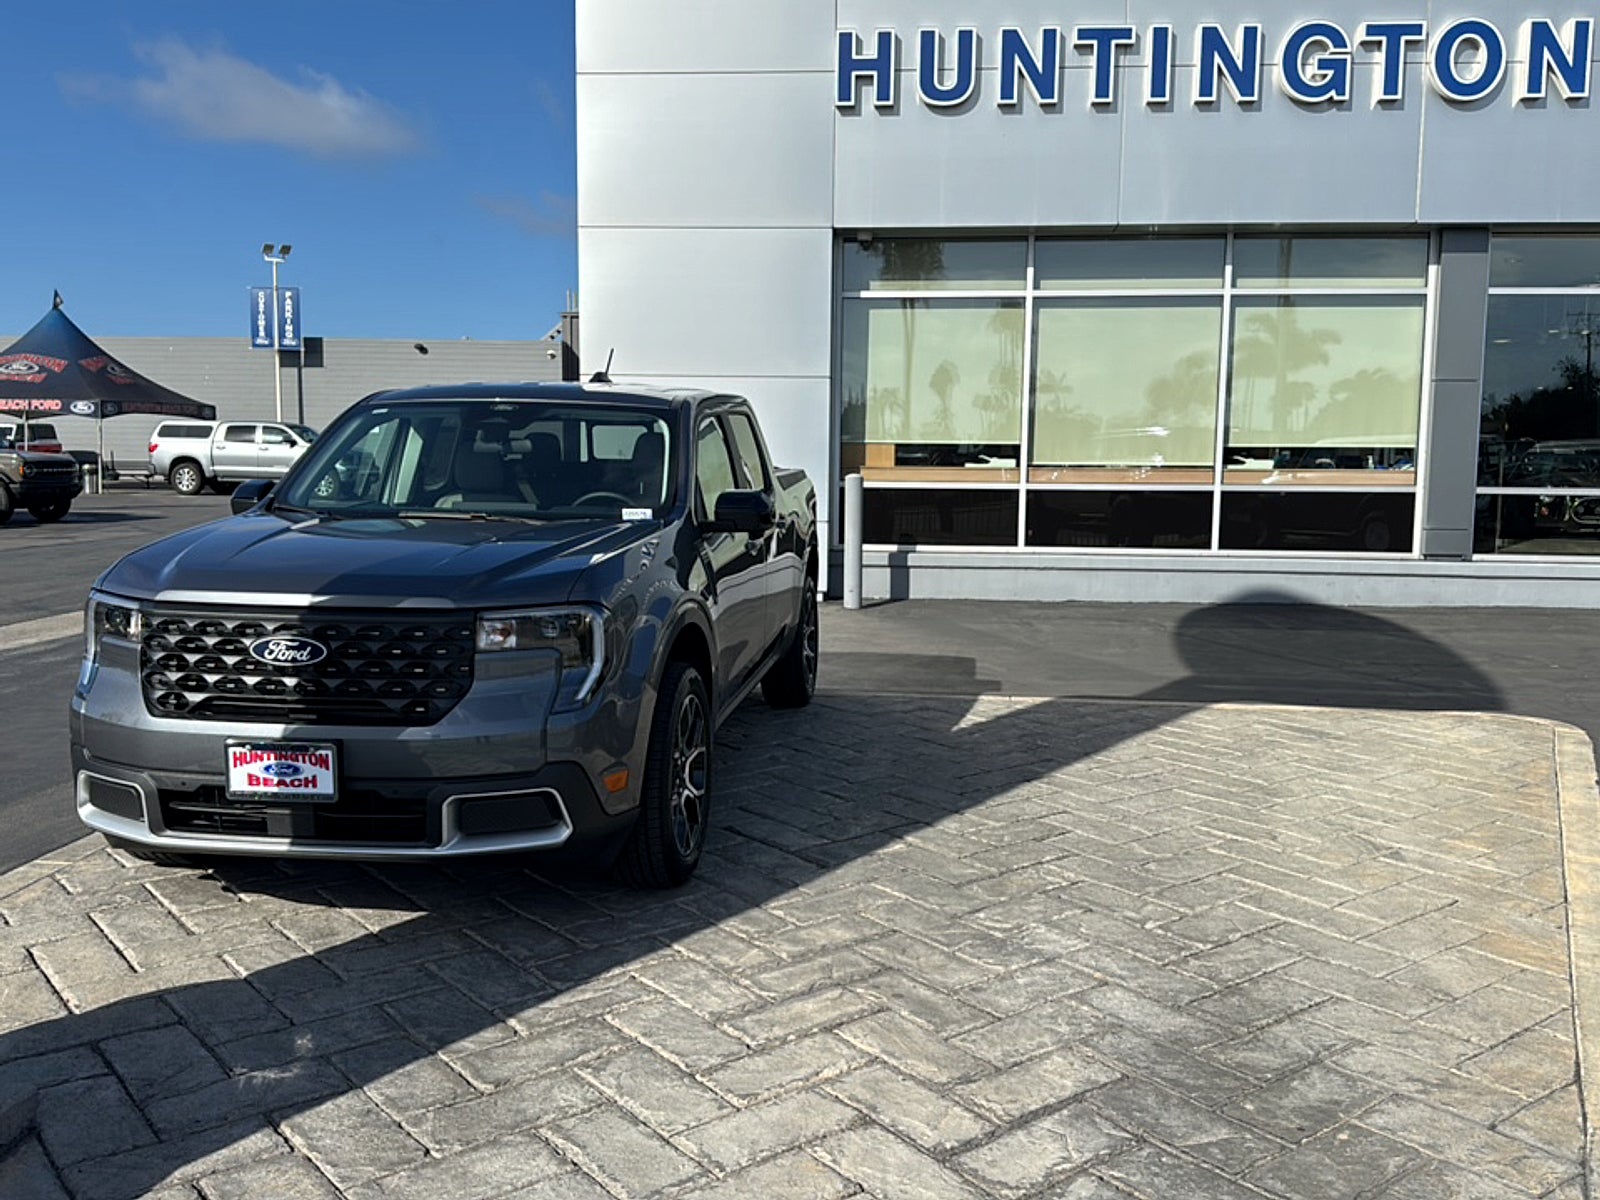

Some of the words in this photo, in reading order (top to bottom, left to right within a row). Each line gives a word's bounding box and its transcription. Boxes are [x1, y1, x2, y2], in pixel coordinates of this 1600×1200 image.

[835, 18, 1594, 108] HUNTINGTON
[285, 291, 293, 338] PARKING
[31, 399, 62, 410] FORD
[264, 640, 311, 661] Ford
[233, 751, 330, 771] HUNTINGTON
[247, 773, 318, 789] BEACH
